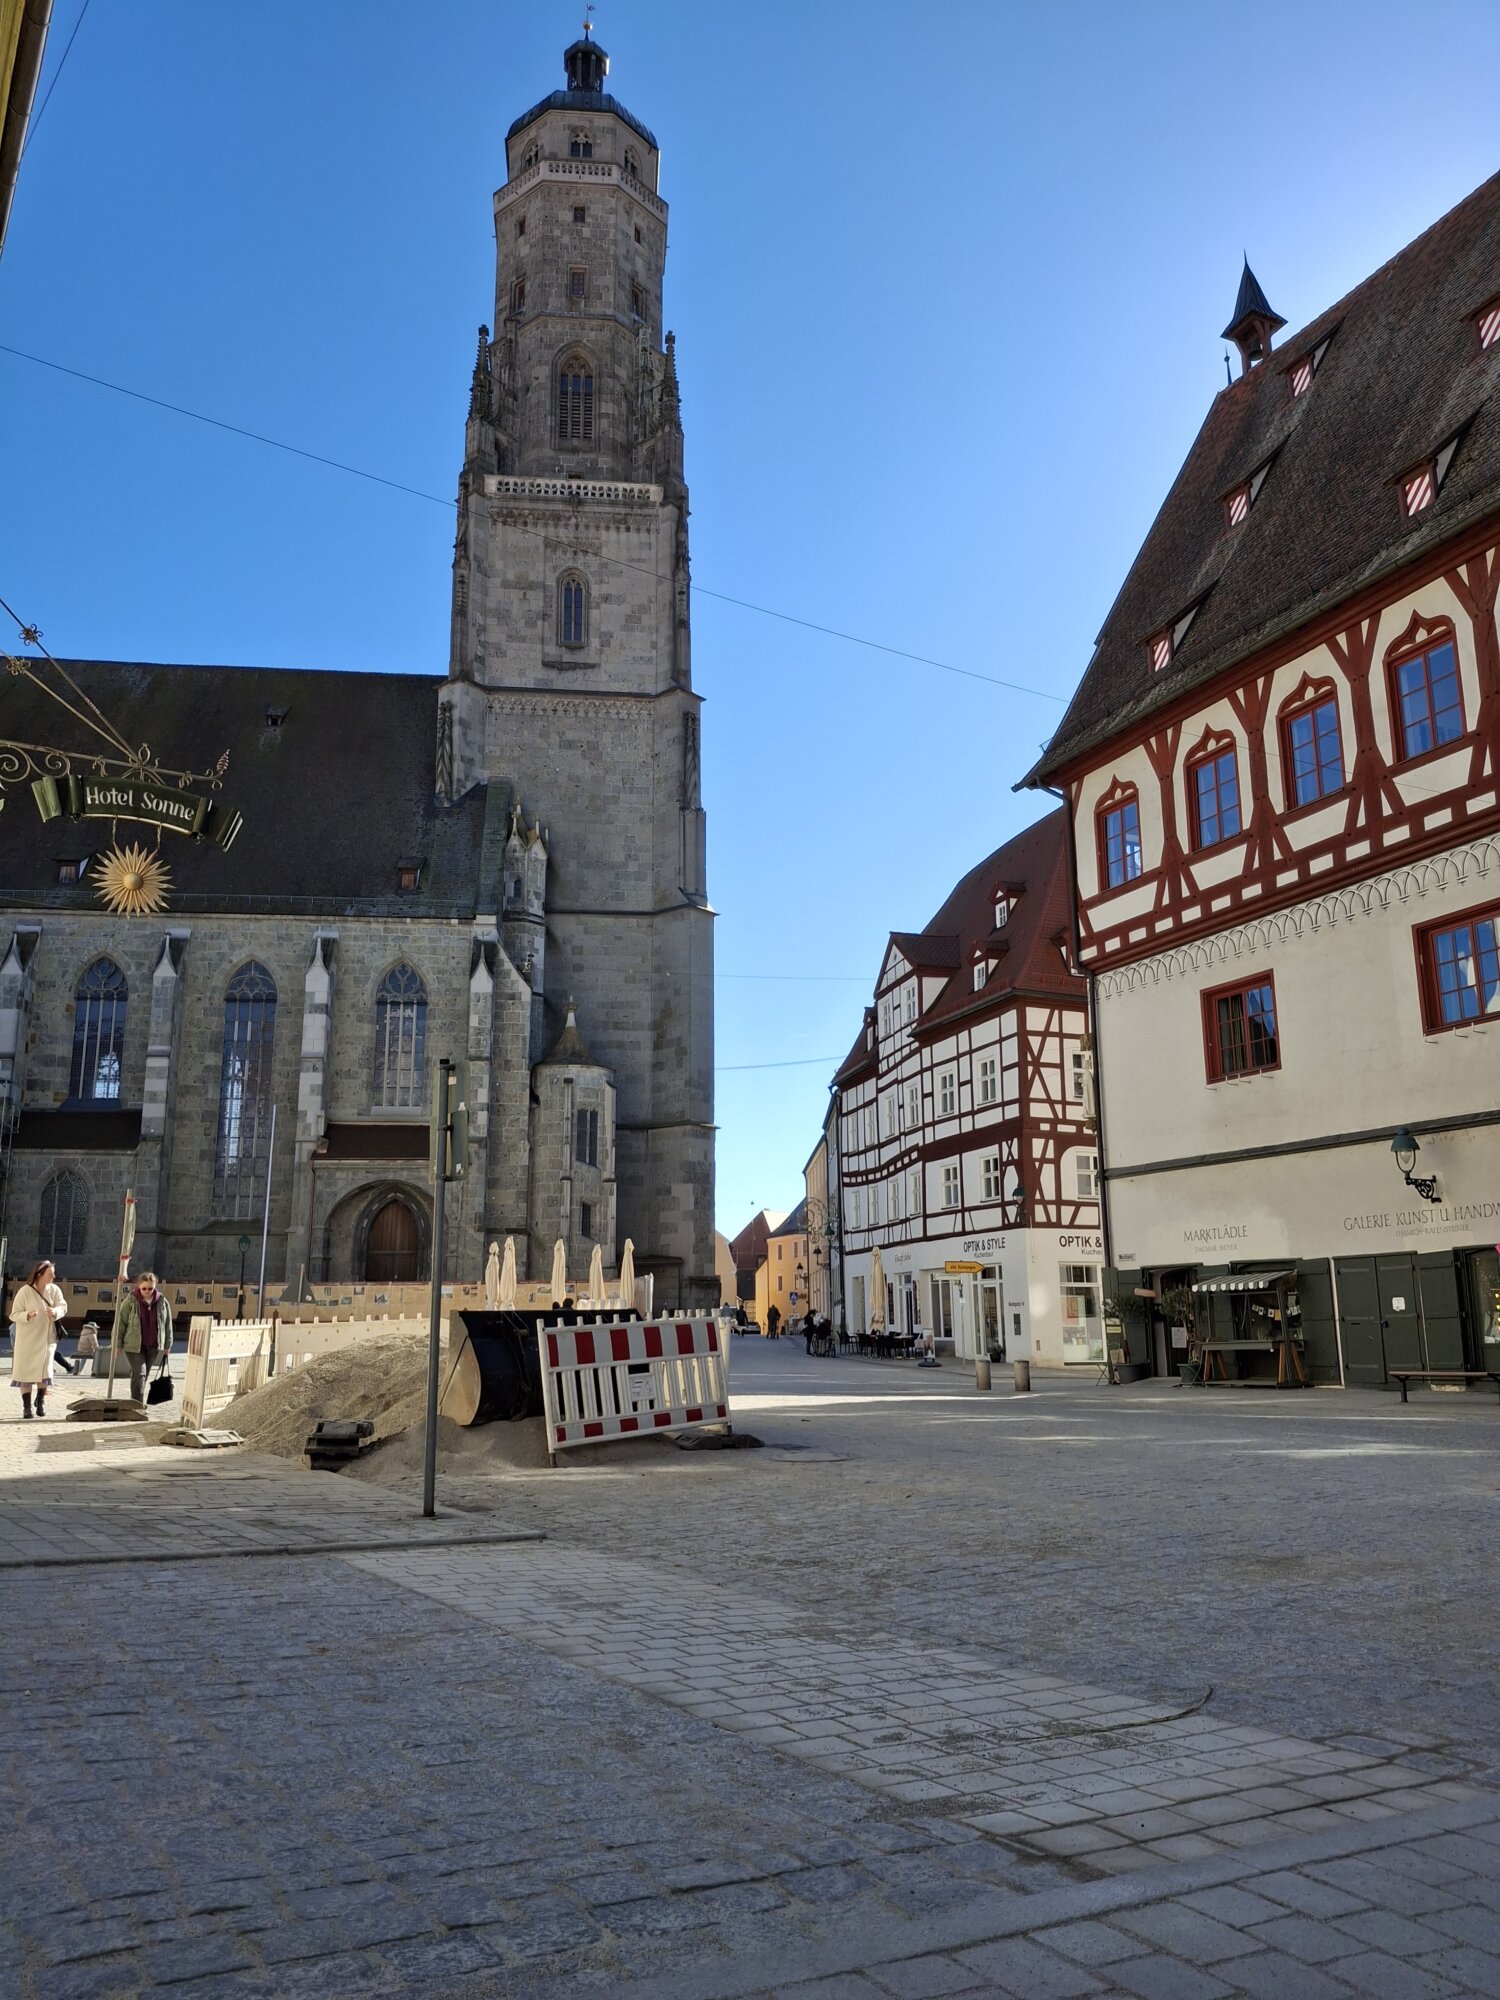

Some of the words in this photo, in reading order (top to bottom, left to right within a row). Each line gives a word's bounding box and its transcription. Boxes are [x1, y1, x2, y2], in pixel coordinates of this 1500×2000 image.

[86, 786, 134, 807] Hotel
[140, 791, 195, 820] Sonne
[1343, 1213, 1391, 1231] GALERIE
[1395, 1209, 1435, 1226] KUNST
[1059, 1235, 1092, 1248] OPTIK
[1094, 1236, 1102, 1248] &
[1183, 1224, 1248, 1243] MARKTLÄDLE
[963, 1240, 980, 1252] OPTIK
[987, 1237, 1006, 1250] STYLE
